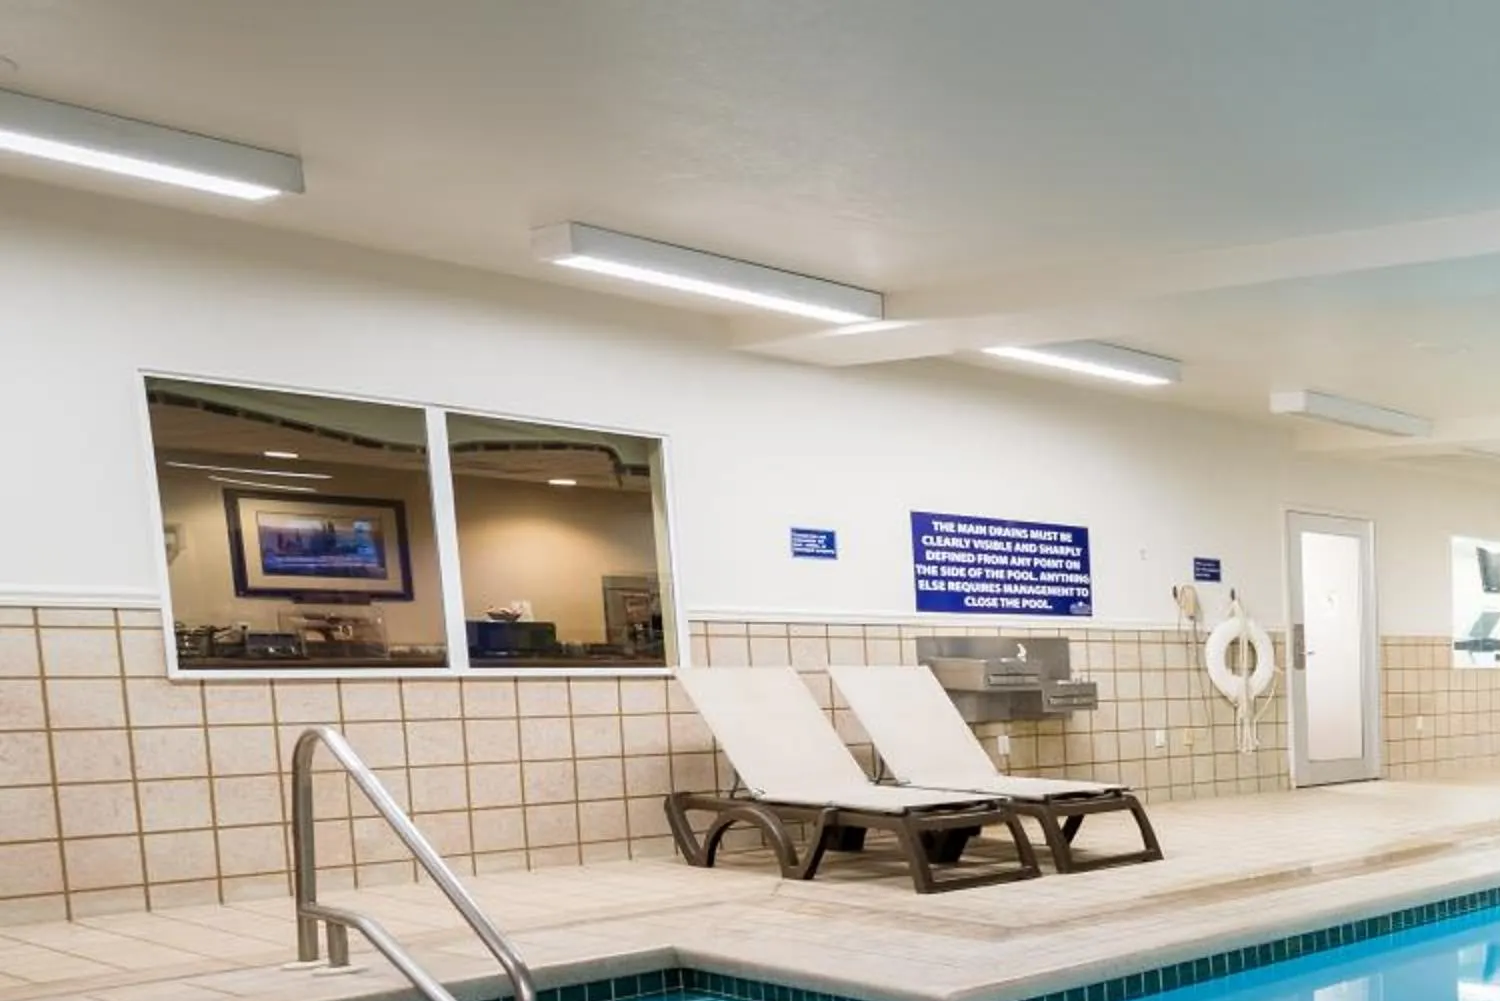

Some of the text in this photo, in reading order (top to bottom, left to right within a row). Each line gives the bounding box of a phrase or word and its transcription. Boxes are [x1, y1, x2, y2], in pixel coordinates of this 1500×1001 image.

[932, 521, 1072, 543] THE MAIN DRAINS MUST BE
[921, 535, 1082, 557] CLEARLY VISIBLE AND SHARPLY
[925, 550, 1081, 571] DEFINED FROM ANY POINT ON
[915, 563, 938, 576] THE
[940, 565, 966, 578] SIDE
[968, 567, 983, 578] OF
[984, 569, 1005, 580] THE
[918, 579, 1089, 598] ELSE REQUIRES MANAGEMENT TO
[1000, 597, 1021, 609] THE
